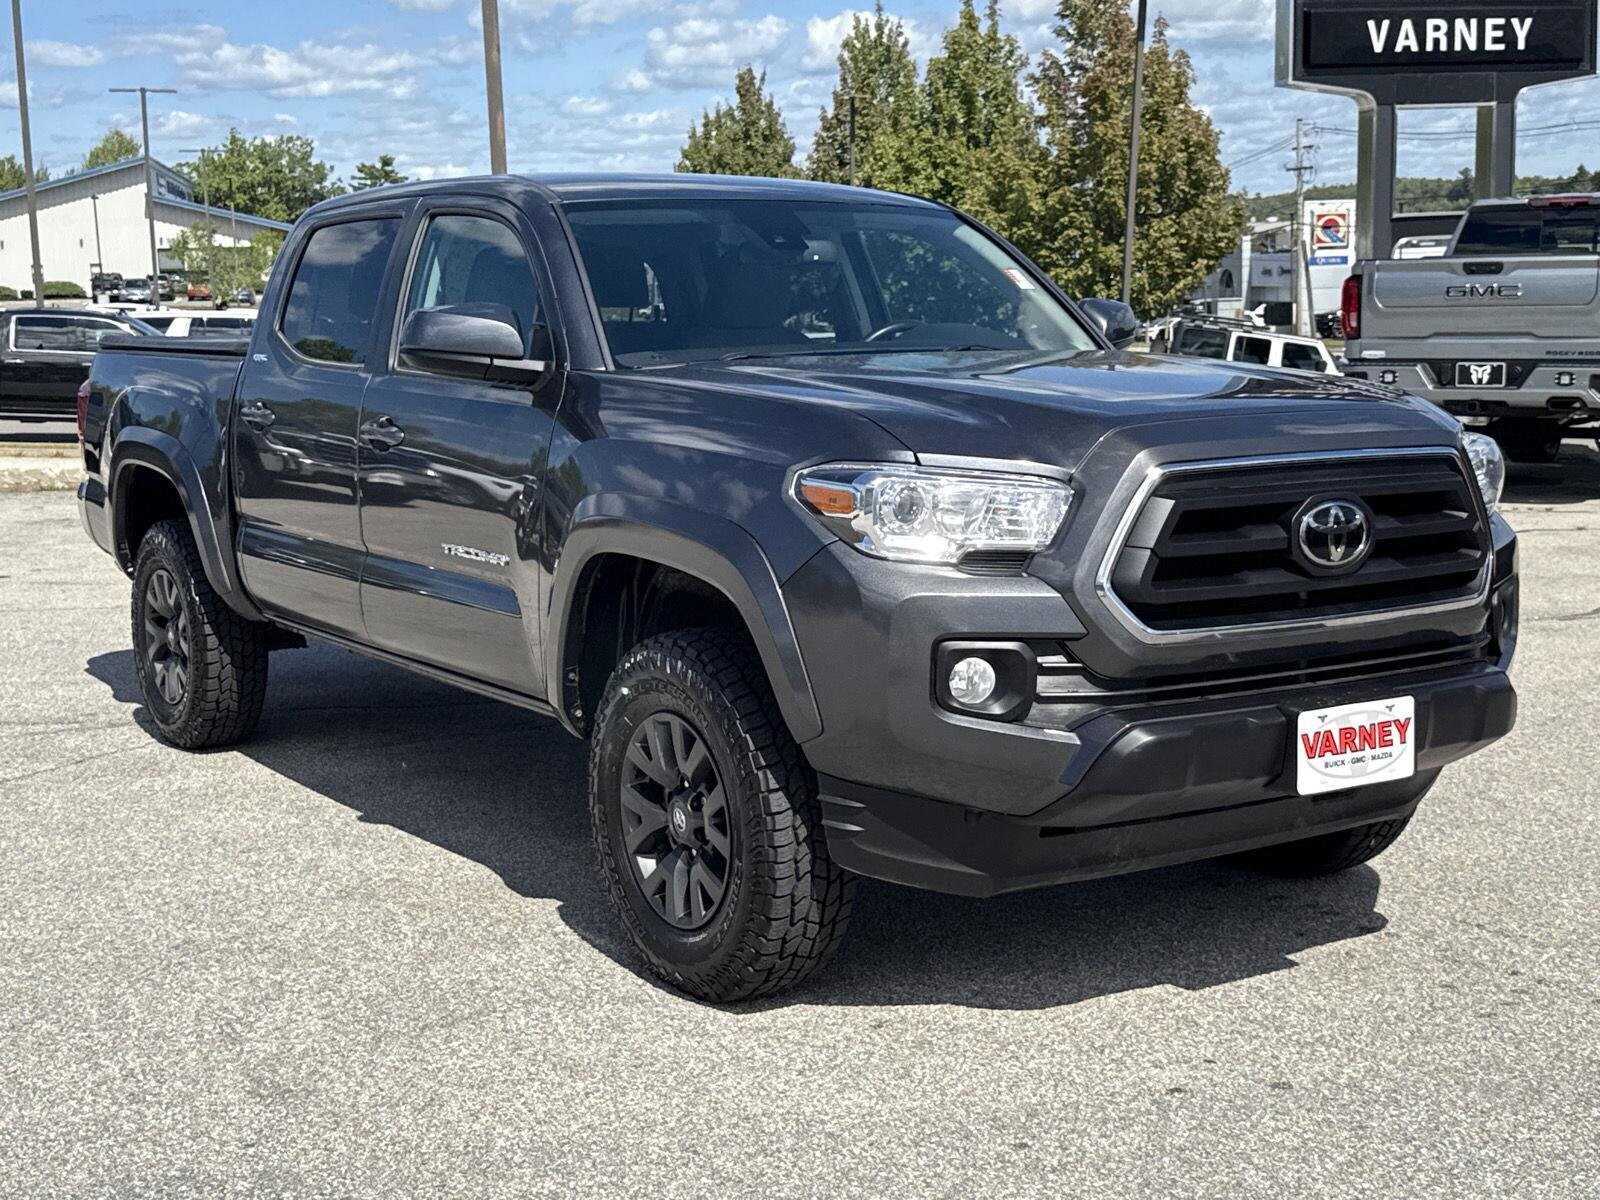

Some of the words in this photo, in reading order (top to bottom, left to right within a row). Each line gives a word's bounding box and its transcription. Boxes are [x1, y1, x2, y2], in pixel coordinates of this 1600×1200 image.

[1366, 17, 1533, 53] VARNEY
[1445, 283, 1523, 298] GMC
[1301, 717, 1411, 760] VARNEY
[1324, 759, 1346, 769] BUICK
[1350, 755, 1366, 765] GMC
[1370, 751, 1393, 762] MAZDA
